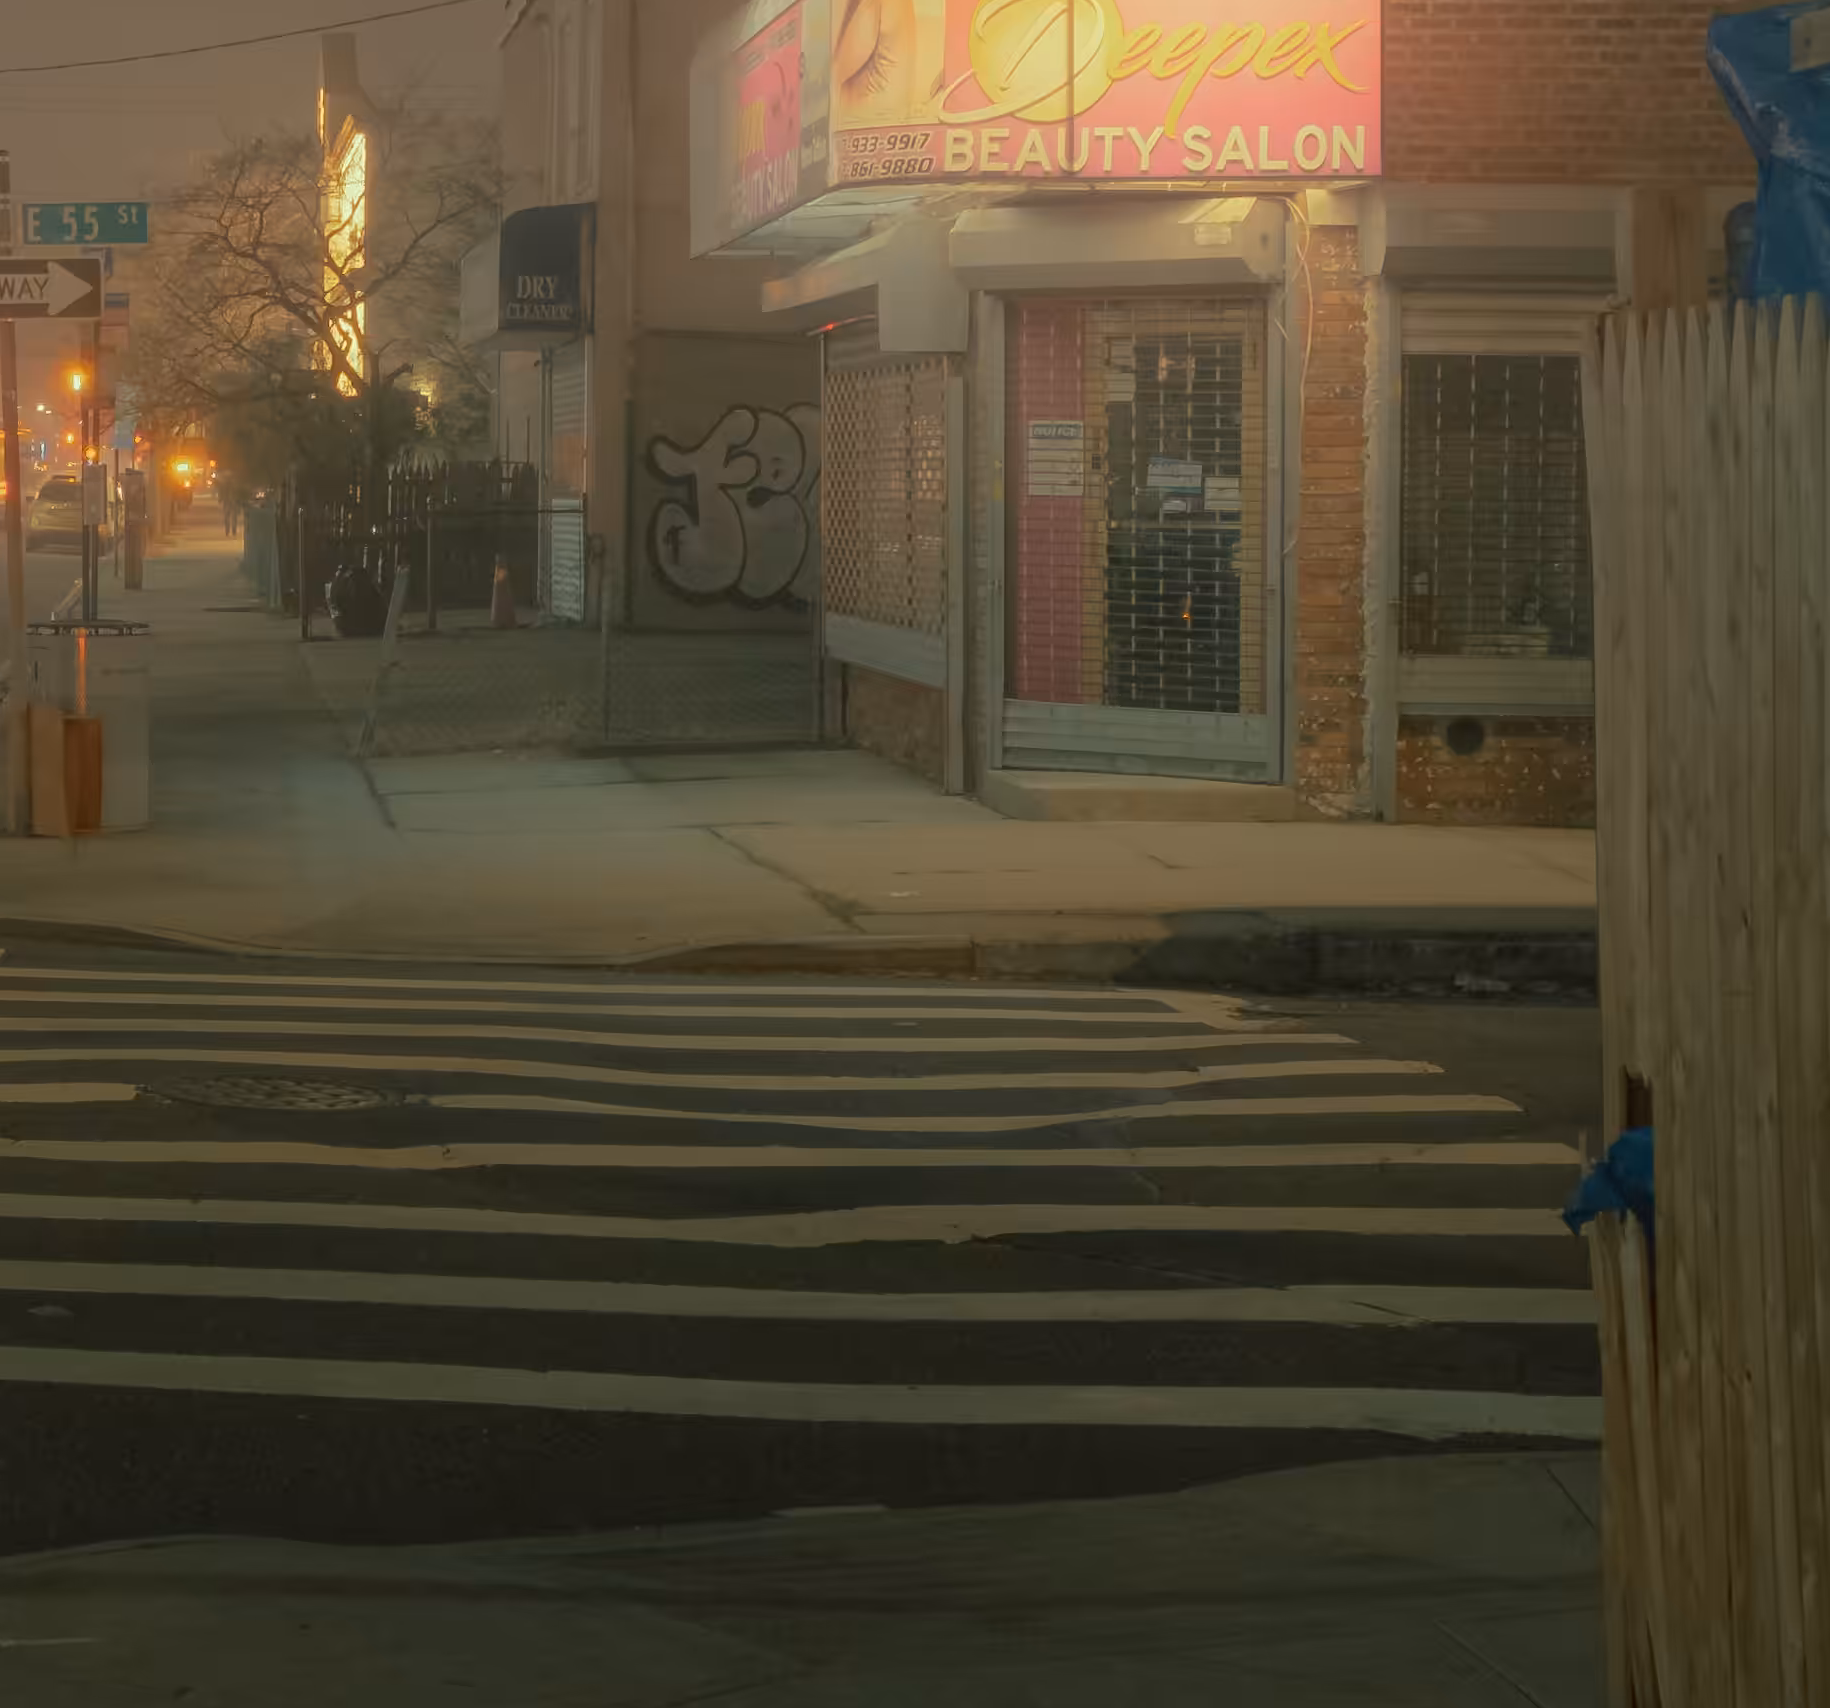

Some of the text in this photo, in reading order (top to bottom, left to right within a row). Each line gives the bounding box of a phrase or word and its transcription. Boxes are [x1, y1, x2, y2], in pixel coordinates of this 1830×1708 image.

[944, 123, 1366, 173] BEAUTY SALON
[26, 207, 42, 242] E
[61, 206, 100, 242] 55
[516, 275, 559, 299] DRY
